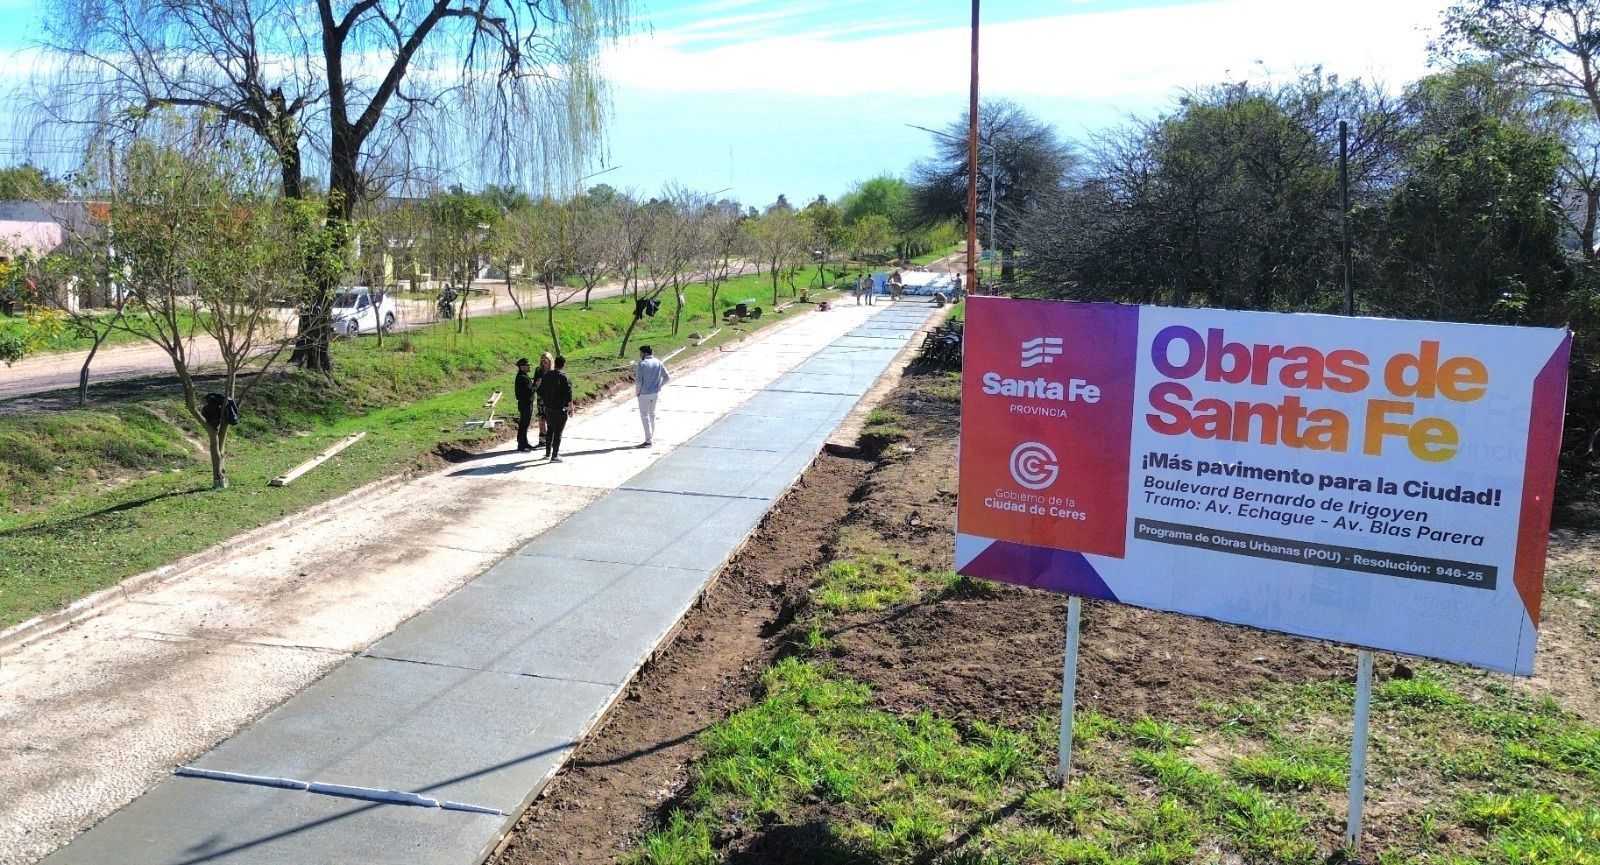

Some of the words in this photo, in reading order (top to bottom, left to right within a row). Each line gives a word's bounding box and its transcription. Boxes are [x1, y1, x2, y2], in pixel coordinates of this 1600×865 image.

[982, 372, 1063, 400] Santa
[1069, 379, 1100, 404] Fe
[1151, 325, 1370, 393] Obras
[1384, 340, 1489, 402] de
[1010, 404, 1067, 418] PROVINCIA
[1146, 382, 1349, 453] Santa
[1363, 399, 1459, 462] Fe
[995, 488, 1045, 504] Gobierno
[1048, 496, 1062, 506] de
[1066, 498, 1075, 507] la
[1142, 452, 1192, 471] ¡Más
[1196, 461, 1314, 486] pavimento
[1318, 474, 1371, 492] para
[1376, 477, 1397, 495] la
[1403, 480, 1502, 506] Ciudad!
[1144, 476, 1230, 498] Boulevard
[1232, 486, 1316, 510] Bernardo
[1320, 498, 1344, 512] de
[1348, 500, 1428, 522] Irigoyen
[984, 497, 1026, 512] Ciudad
[1030, 505, 1046, 516] de
[1050, 507, 1086, 520] Ceres
[1144, 491, 1200, 510] Tramo:
[1205, 500, 1232, 514] Av.
[1238, 504, 1315, 526] Echague
[1333, 516, 1362, 532] Av.
[1370, 520, 1411, 538] Blas
[1416, 526, 1484, 546] Parera
[1138, 524, 1192, 541] Programa
[1195, 532, 1209, 543] de
[1212, 535, 1246, 549] Obras
[1250, 540, 1300, 556] Urbanas
[1304, 548, 1340, 564] (POU)
[1354, 555, 1430, 574] Resolución:
[1436, 566, 1484, 582] 946-25
